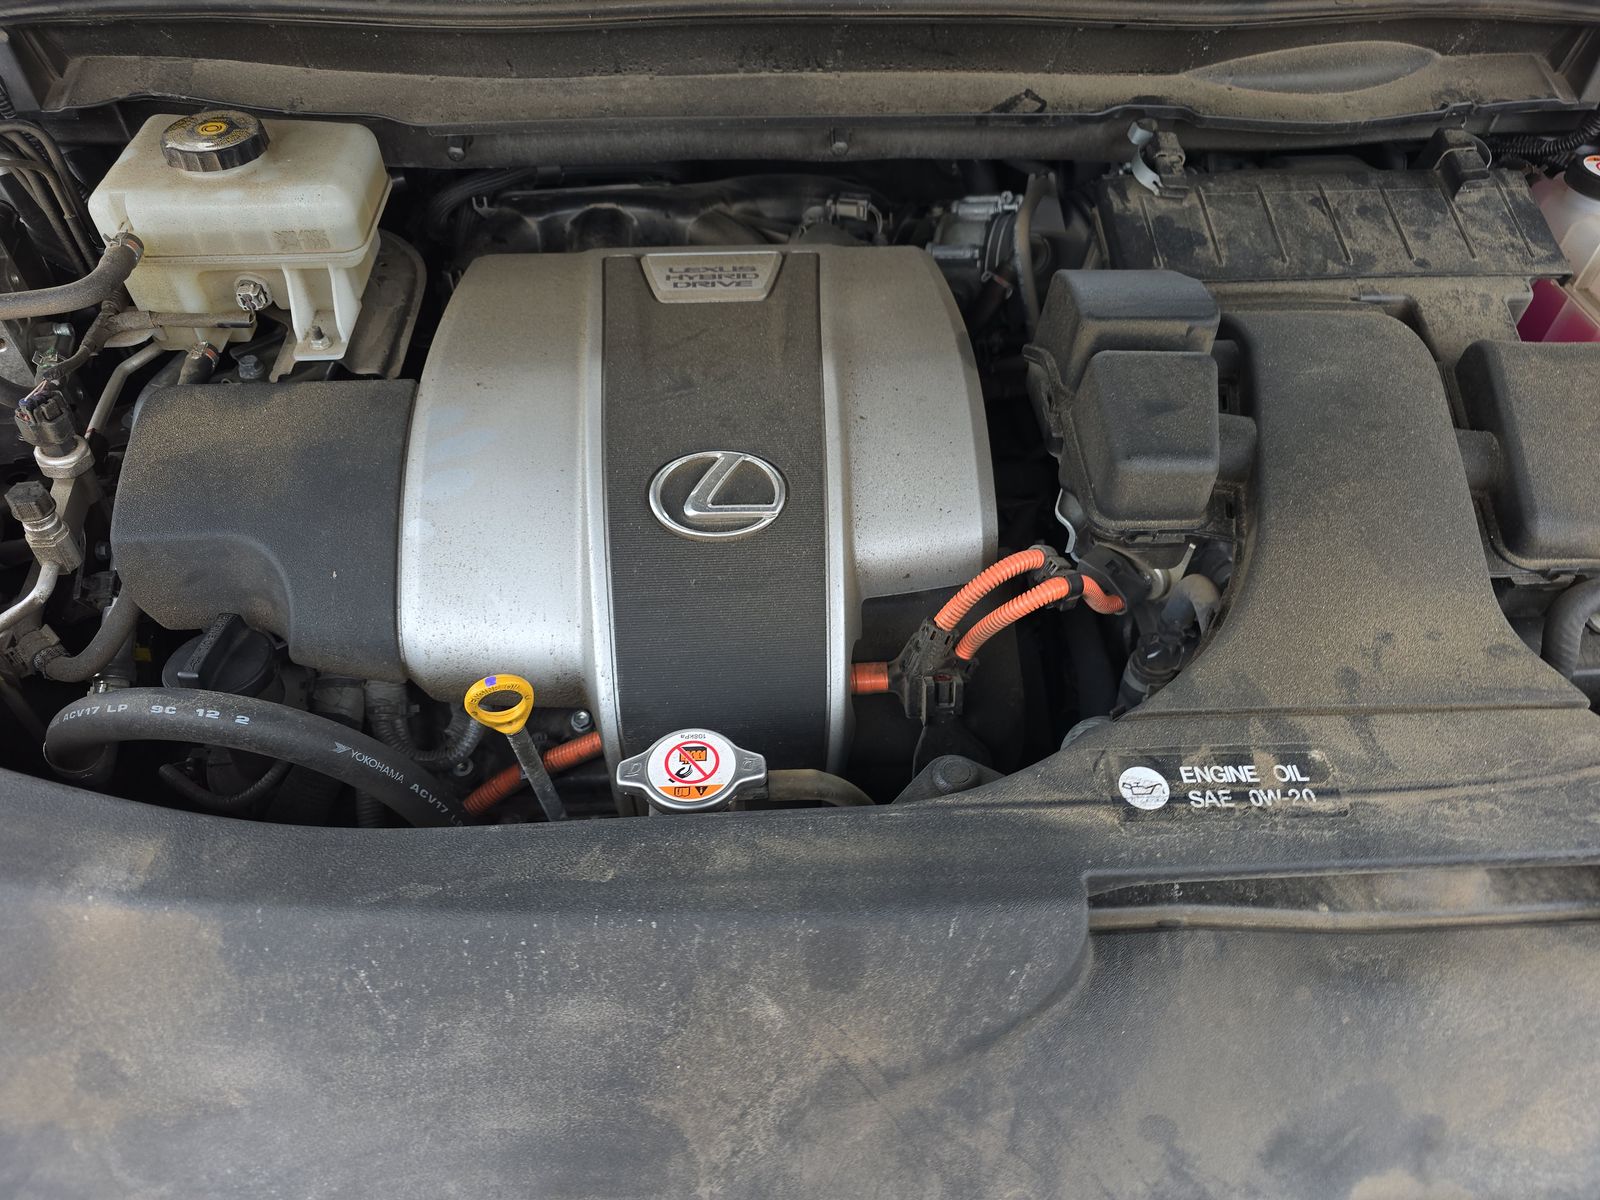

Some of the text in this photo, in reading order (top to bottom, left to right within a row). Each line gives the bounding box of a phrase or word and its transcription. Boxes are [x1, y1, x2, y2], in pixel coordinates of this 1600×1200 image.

[666, 273, 760, 281] HYBRID
[673, 280, 753, 288] DRIVE
[62, 704, 250, 725] ACV17 LP 9C 12 2
[350, 748, 405, 784] YOKOHAMA
[409, 783, 449, 814] ACV17
[1179, 764, 1310, 784] ENGINE OIL
[1187, 788, 1317, 808] SAE 0W-20
